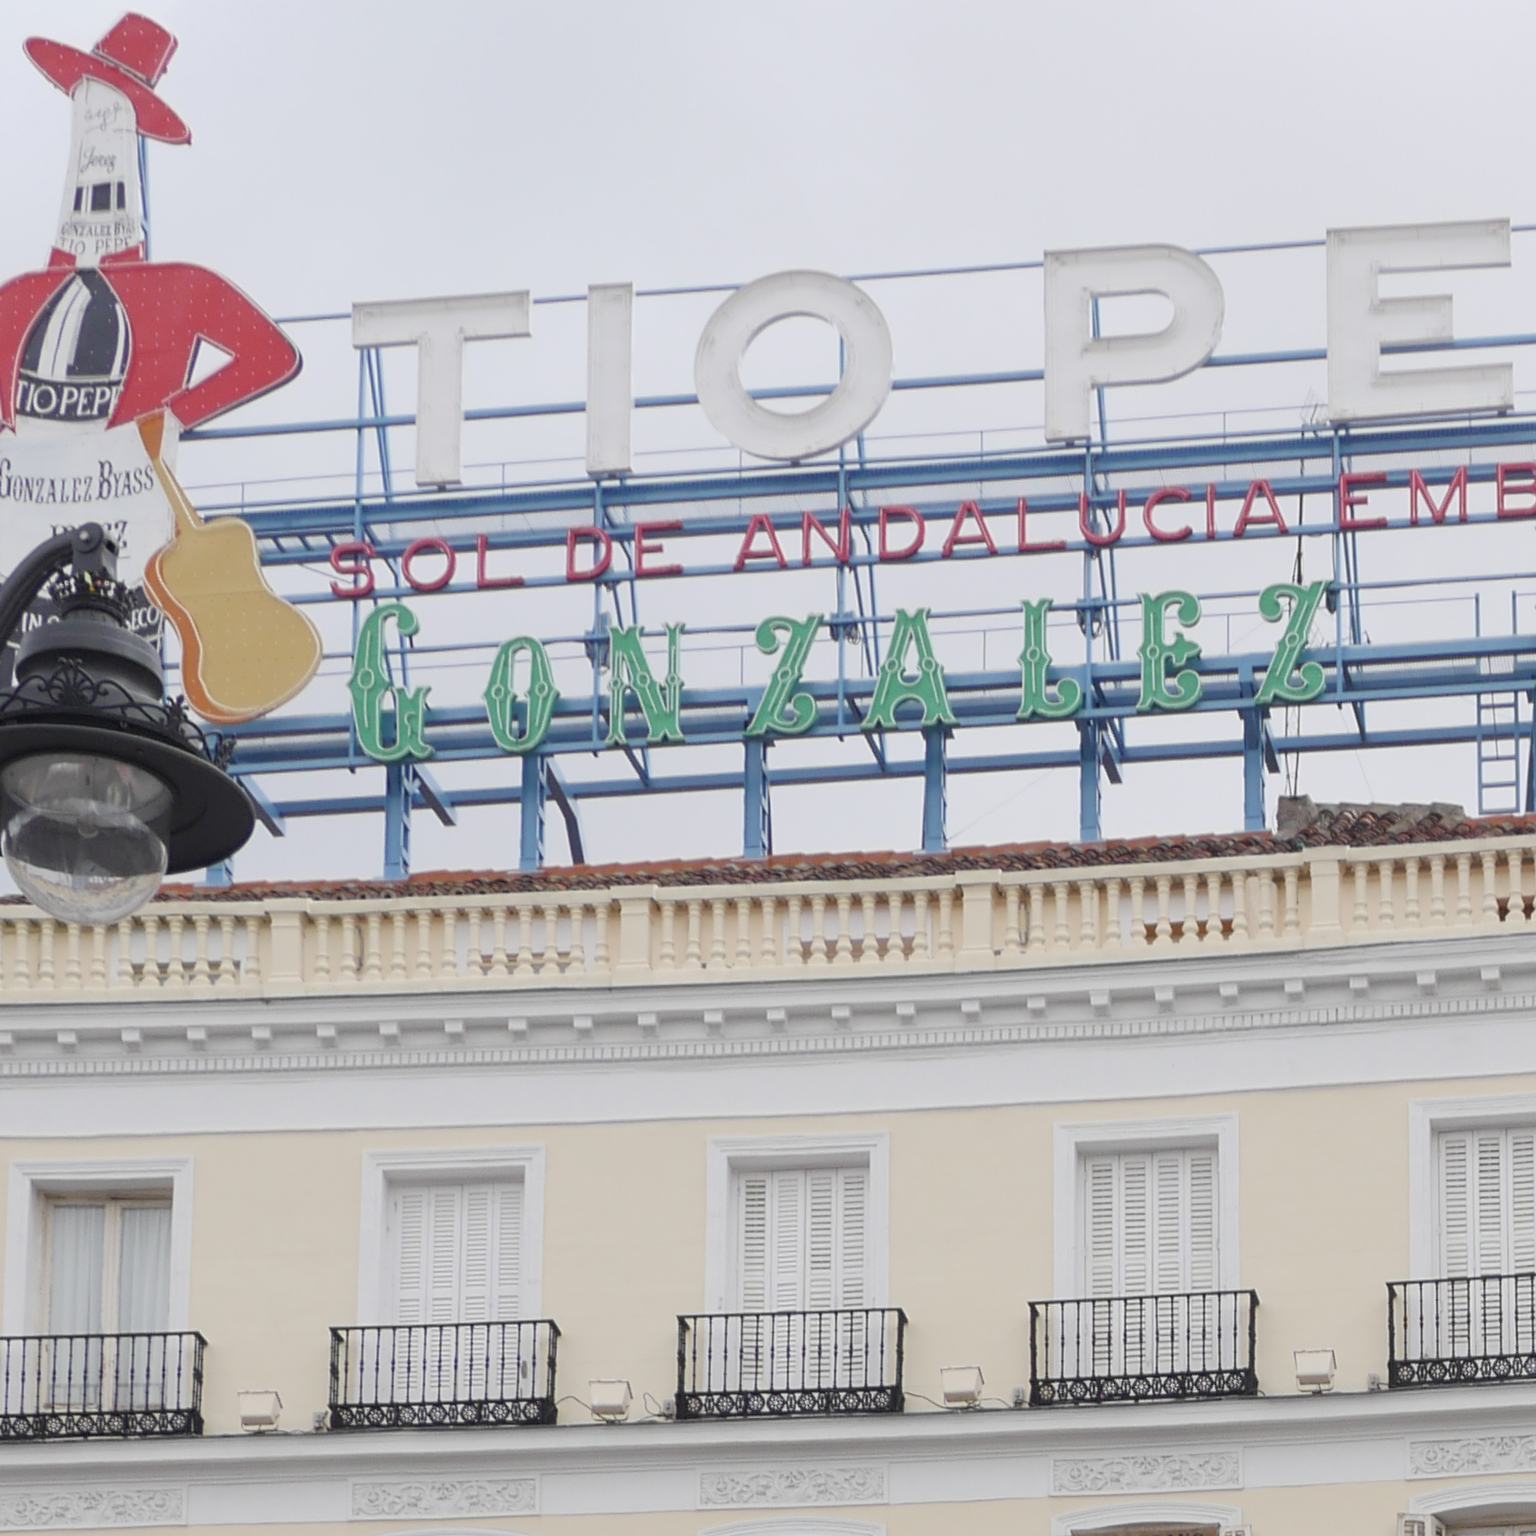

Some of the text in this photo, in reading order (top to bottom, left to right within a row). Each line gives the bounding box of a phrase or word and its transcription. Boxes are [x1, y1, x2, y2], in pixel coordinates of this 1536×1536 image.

[352, 269, 893, 487] TIO
[0, 458, 155, 504] GONZALEZ BYASS
[330, 533, 525, 599] SOL
[566, 520, 683, 580] DE
[733, 478, 1289, 569] ANDALUCIA
[125, 607, 160, 630] ECO
[349, 580, 1334, 765] GONZALEZ
